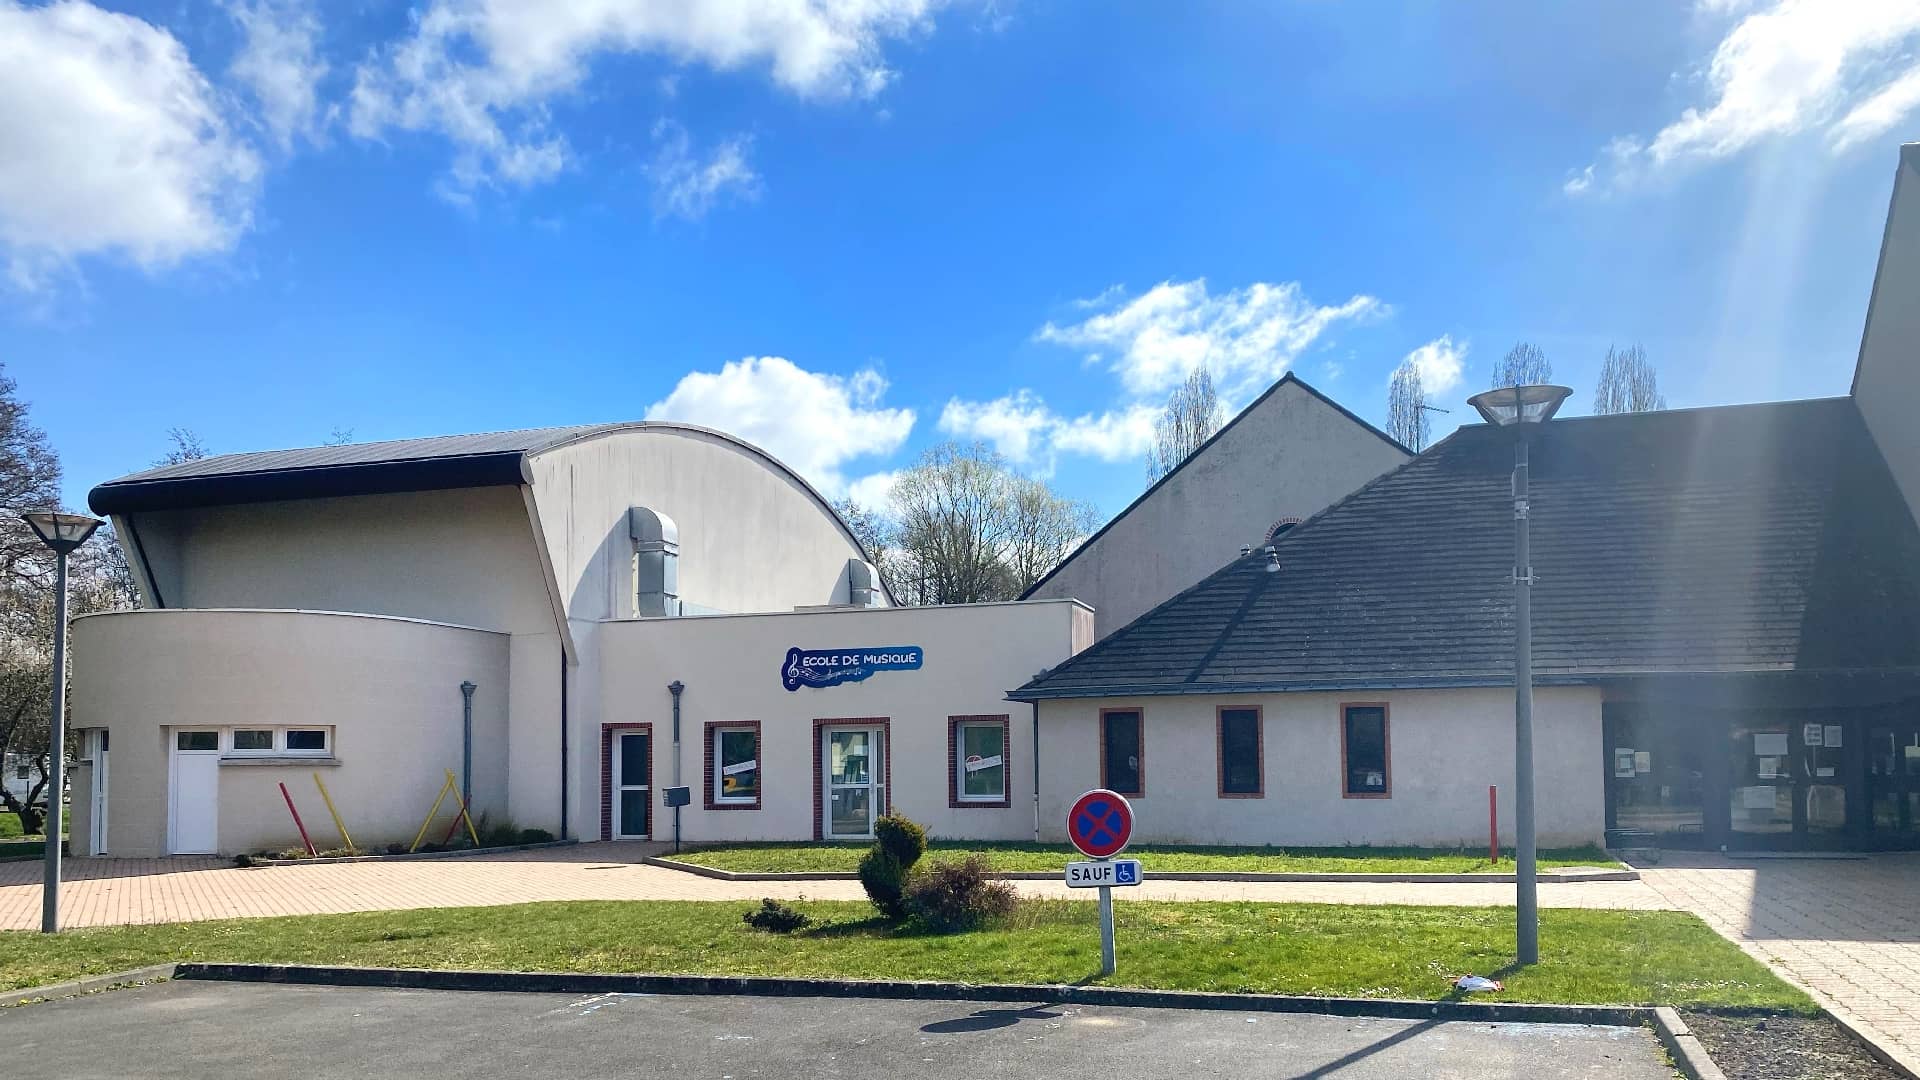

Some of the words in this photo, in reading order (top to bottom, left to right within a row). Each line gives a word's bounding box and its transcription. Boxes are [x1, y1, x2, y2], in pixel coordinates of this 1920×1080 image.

[802, 656, 839, 667] ECOLE
[842, 654, 860, 666] DE
[863, 652, 917, 664] MUSIQUE
[1071, 867, 1111, 881] SAUF
